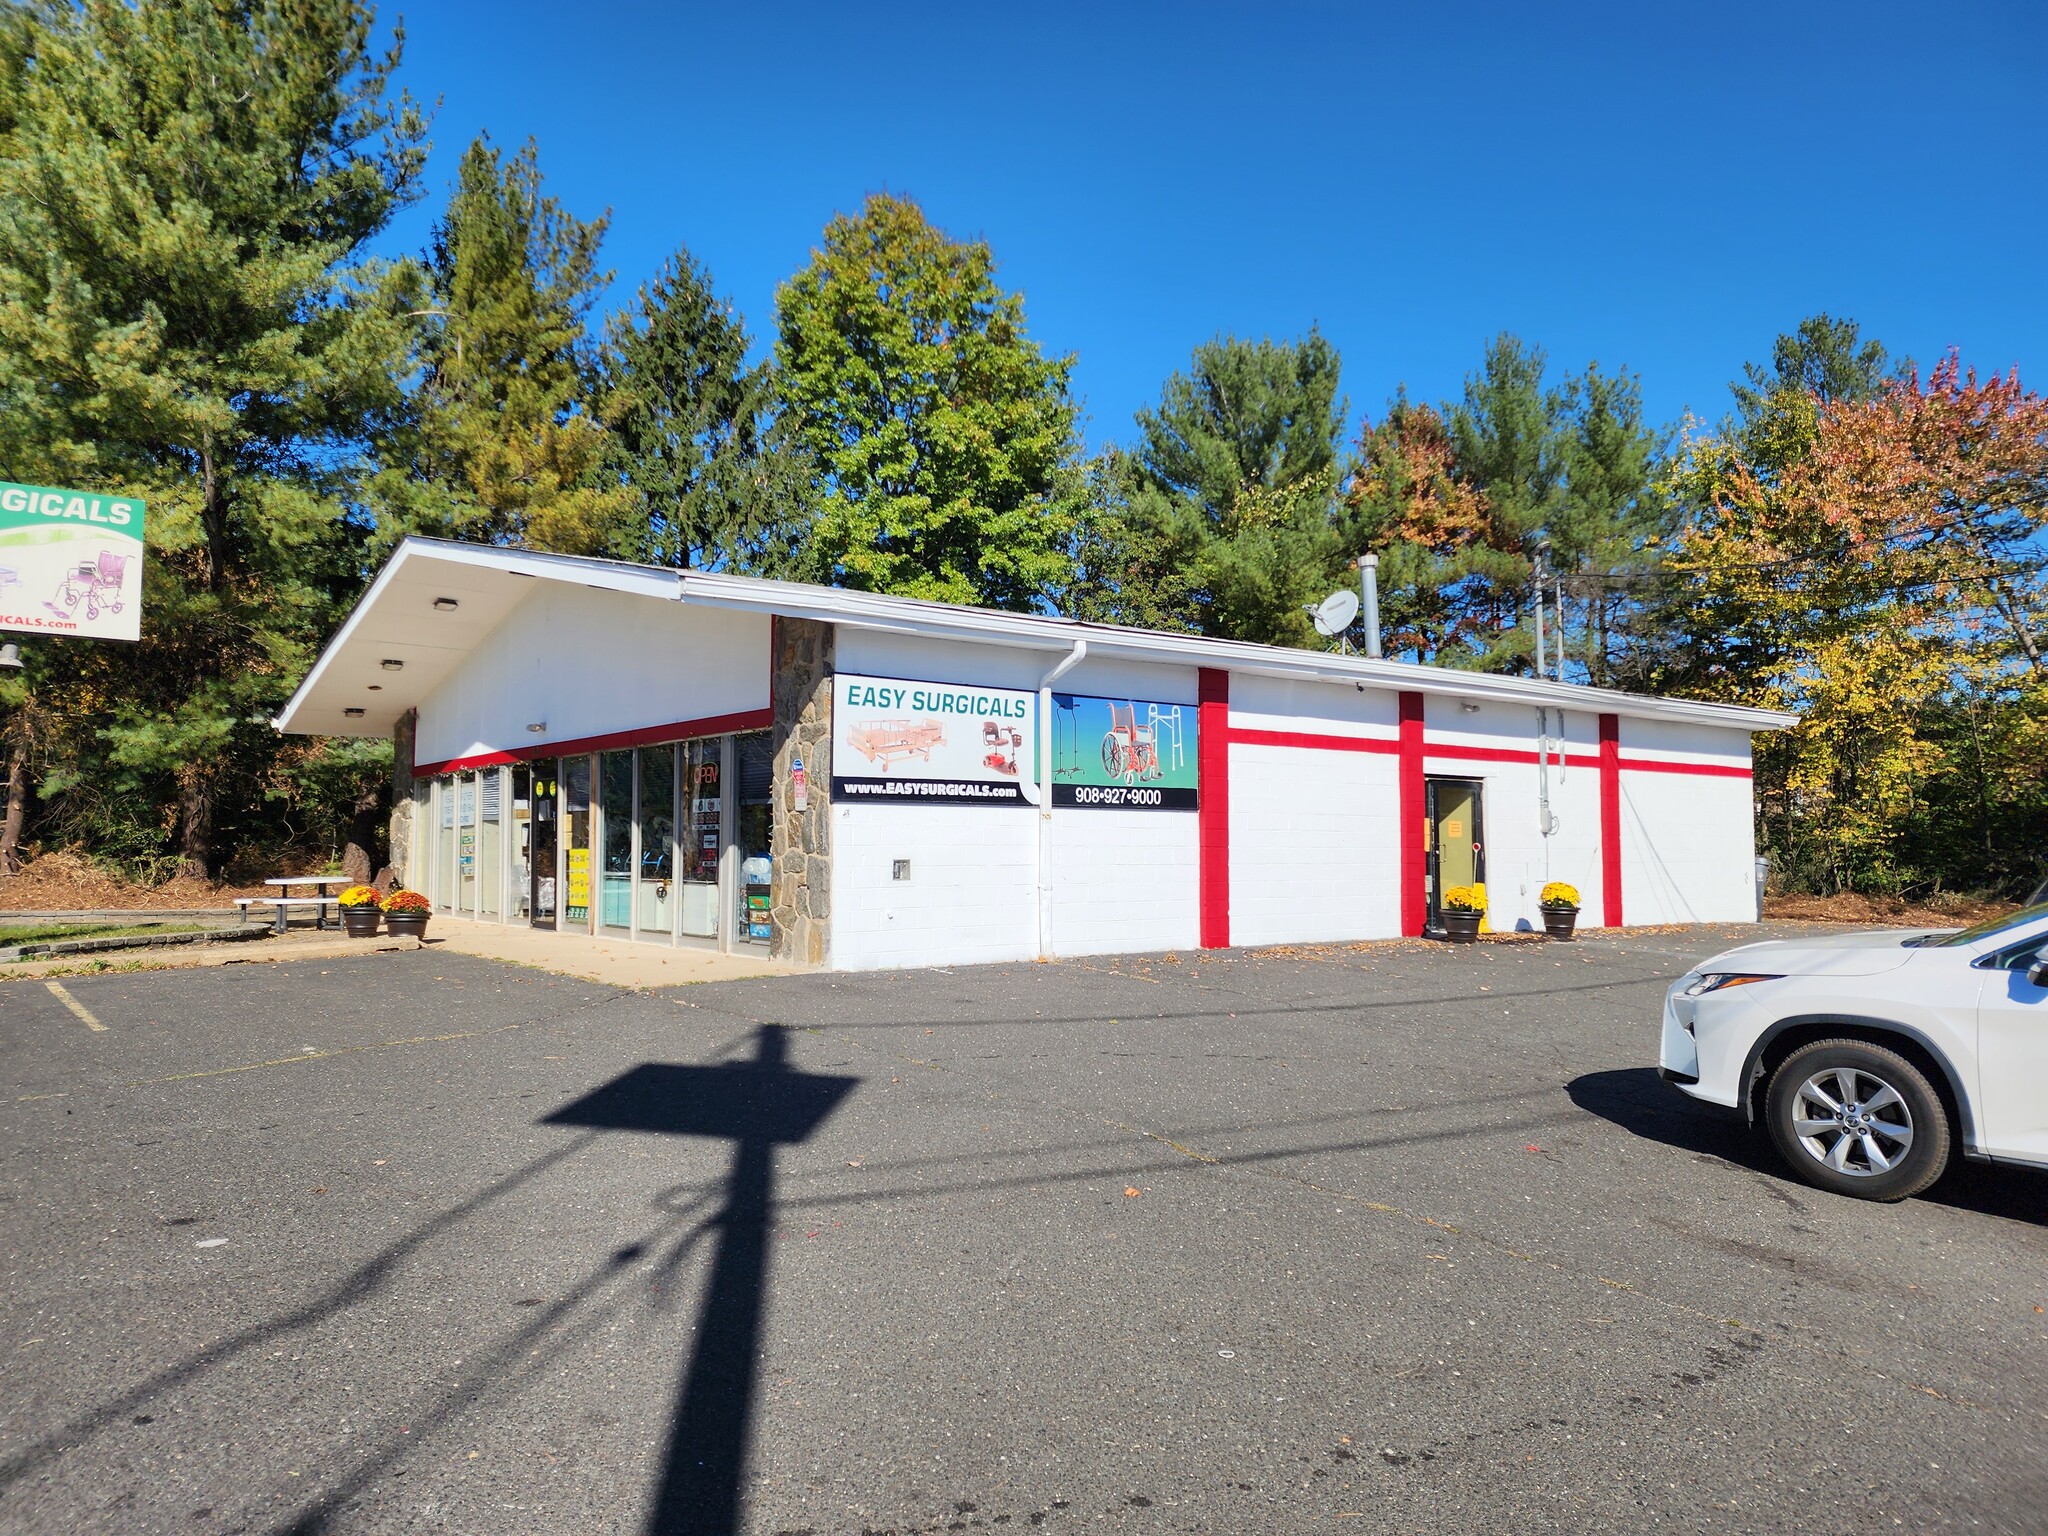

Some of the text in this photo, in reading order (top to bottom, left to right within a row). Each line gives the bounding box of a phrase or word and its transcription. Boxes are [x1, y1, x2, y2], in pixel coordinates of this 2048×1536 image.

[0, 488, 132, 525] GICALS
[847, 685, 1026, 719] EASY SURGICALS
[693, 766, 718, 785] OPEN
[843, 782, 1017, 798] www.EASYSURGICALS.com
